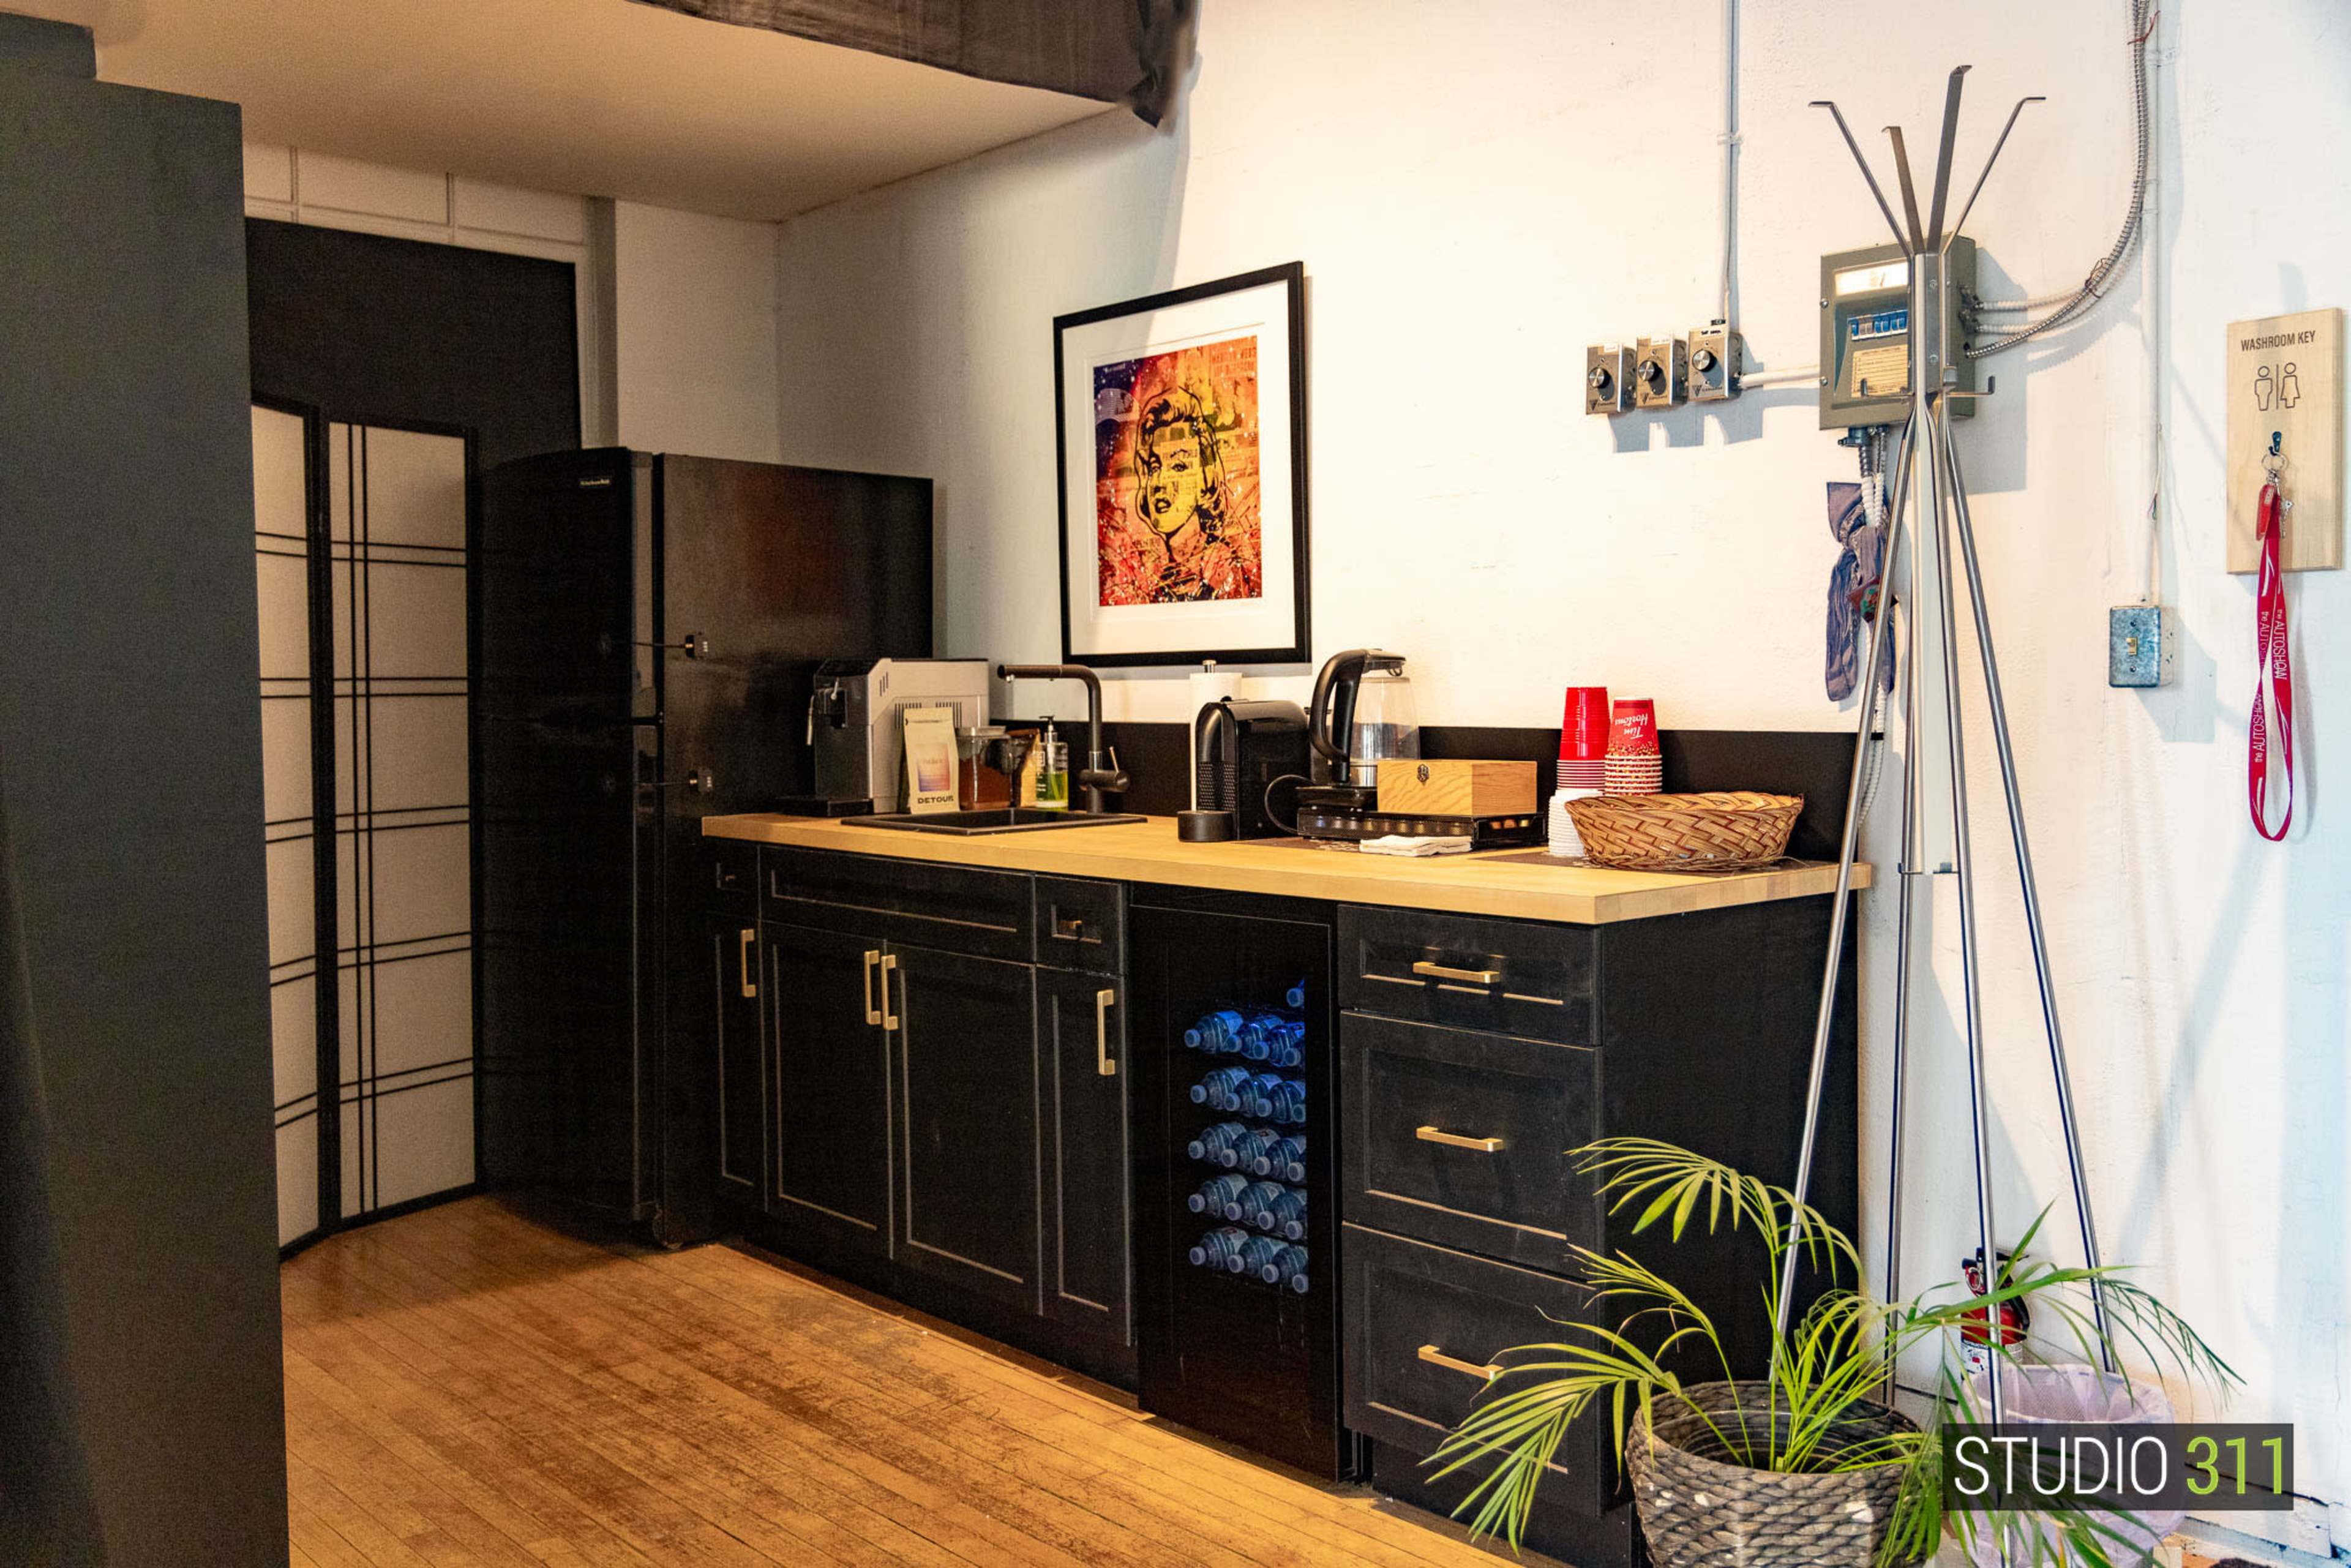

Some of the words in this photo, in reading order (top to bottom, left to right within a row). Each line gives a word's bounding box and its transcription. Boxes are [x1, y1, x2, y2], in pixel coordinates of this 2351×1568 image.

[2241, 332, 2295, 351] WASHROOM
[2298, 330, 2316, 344] KEY
[2273, 620, 2287, 680] AUTOSHOW
[1615, 713, 1648, 727] Hortons
[1624, 726, 1643, 740] Tim
